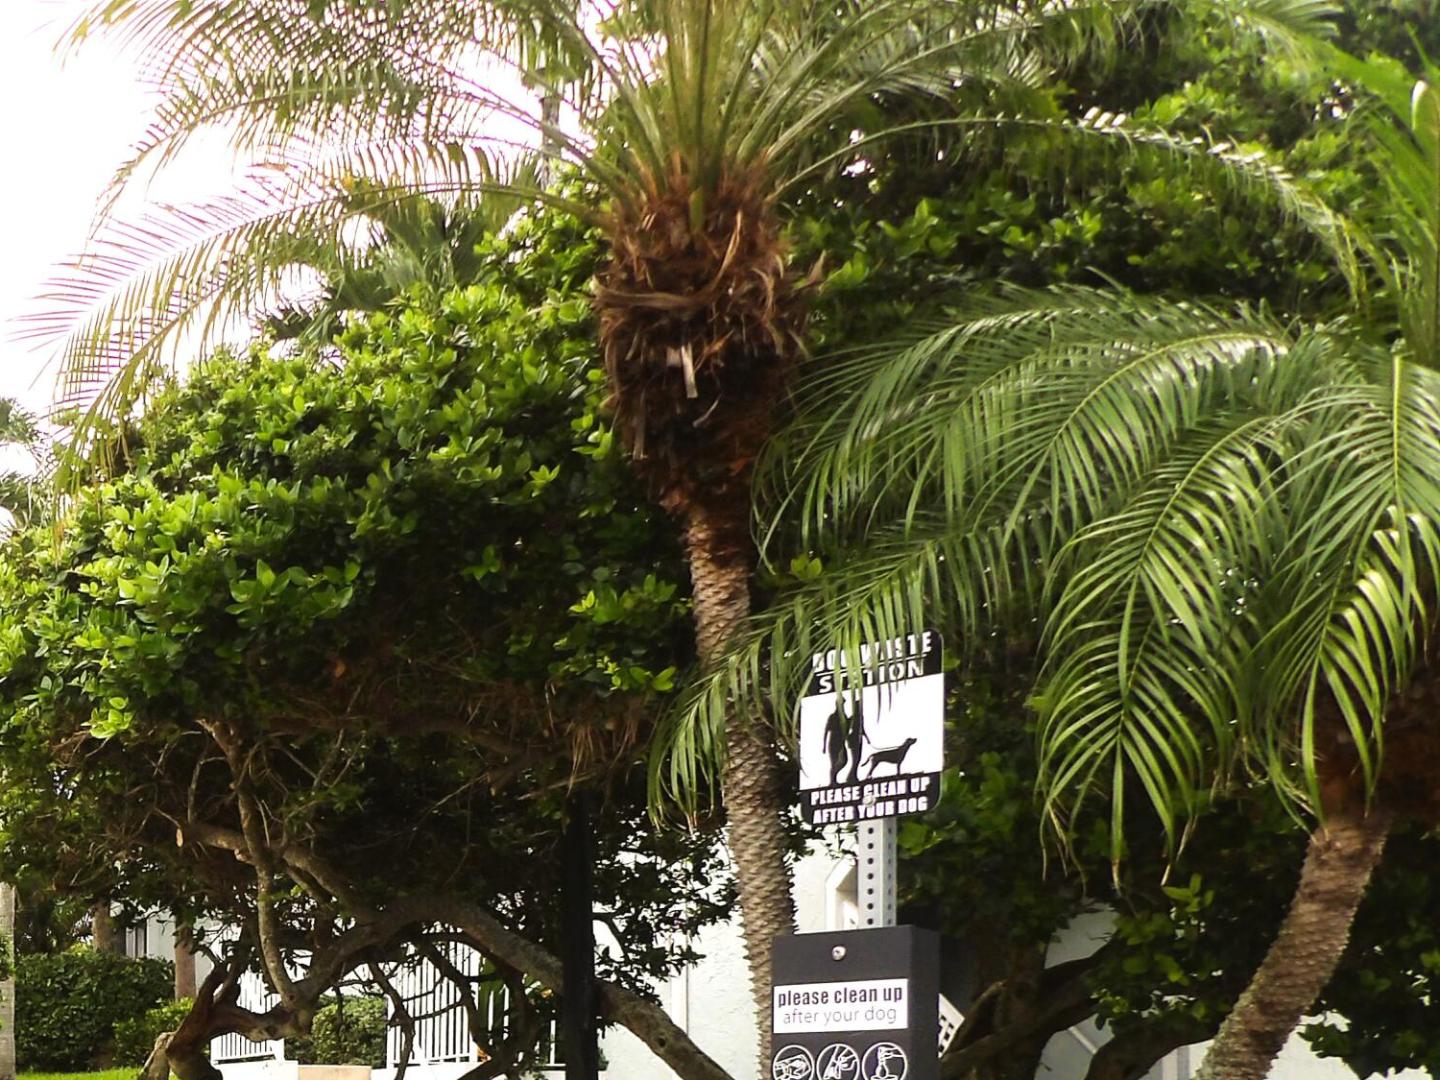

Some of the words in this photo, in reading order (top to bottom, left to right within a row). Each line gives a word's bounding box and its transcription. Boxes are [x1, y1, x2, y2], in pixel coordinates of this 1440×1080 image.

[818, 660, 925, 694] STION
[811, 785, 860, 806] PLEASE
[863, 779, 907, 799] CLEAN
[910, 776, 931, 793] UP
[813, 805, 855, 824] AFTER
[857, 800, 895, 819] YOUR
[898, 796, 928, 815] DOG
[778, 989, 829, 1008] please
[834, 987, 878, 1004] clean
[883, 986, 903, 1003] up
[783, 1008, 819, 1025] after
[823, 1009, 860, 1026] your
[864, 1006, 897, 1025] dog
